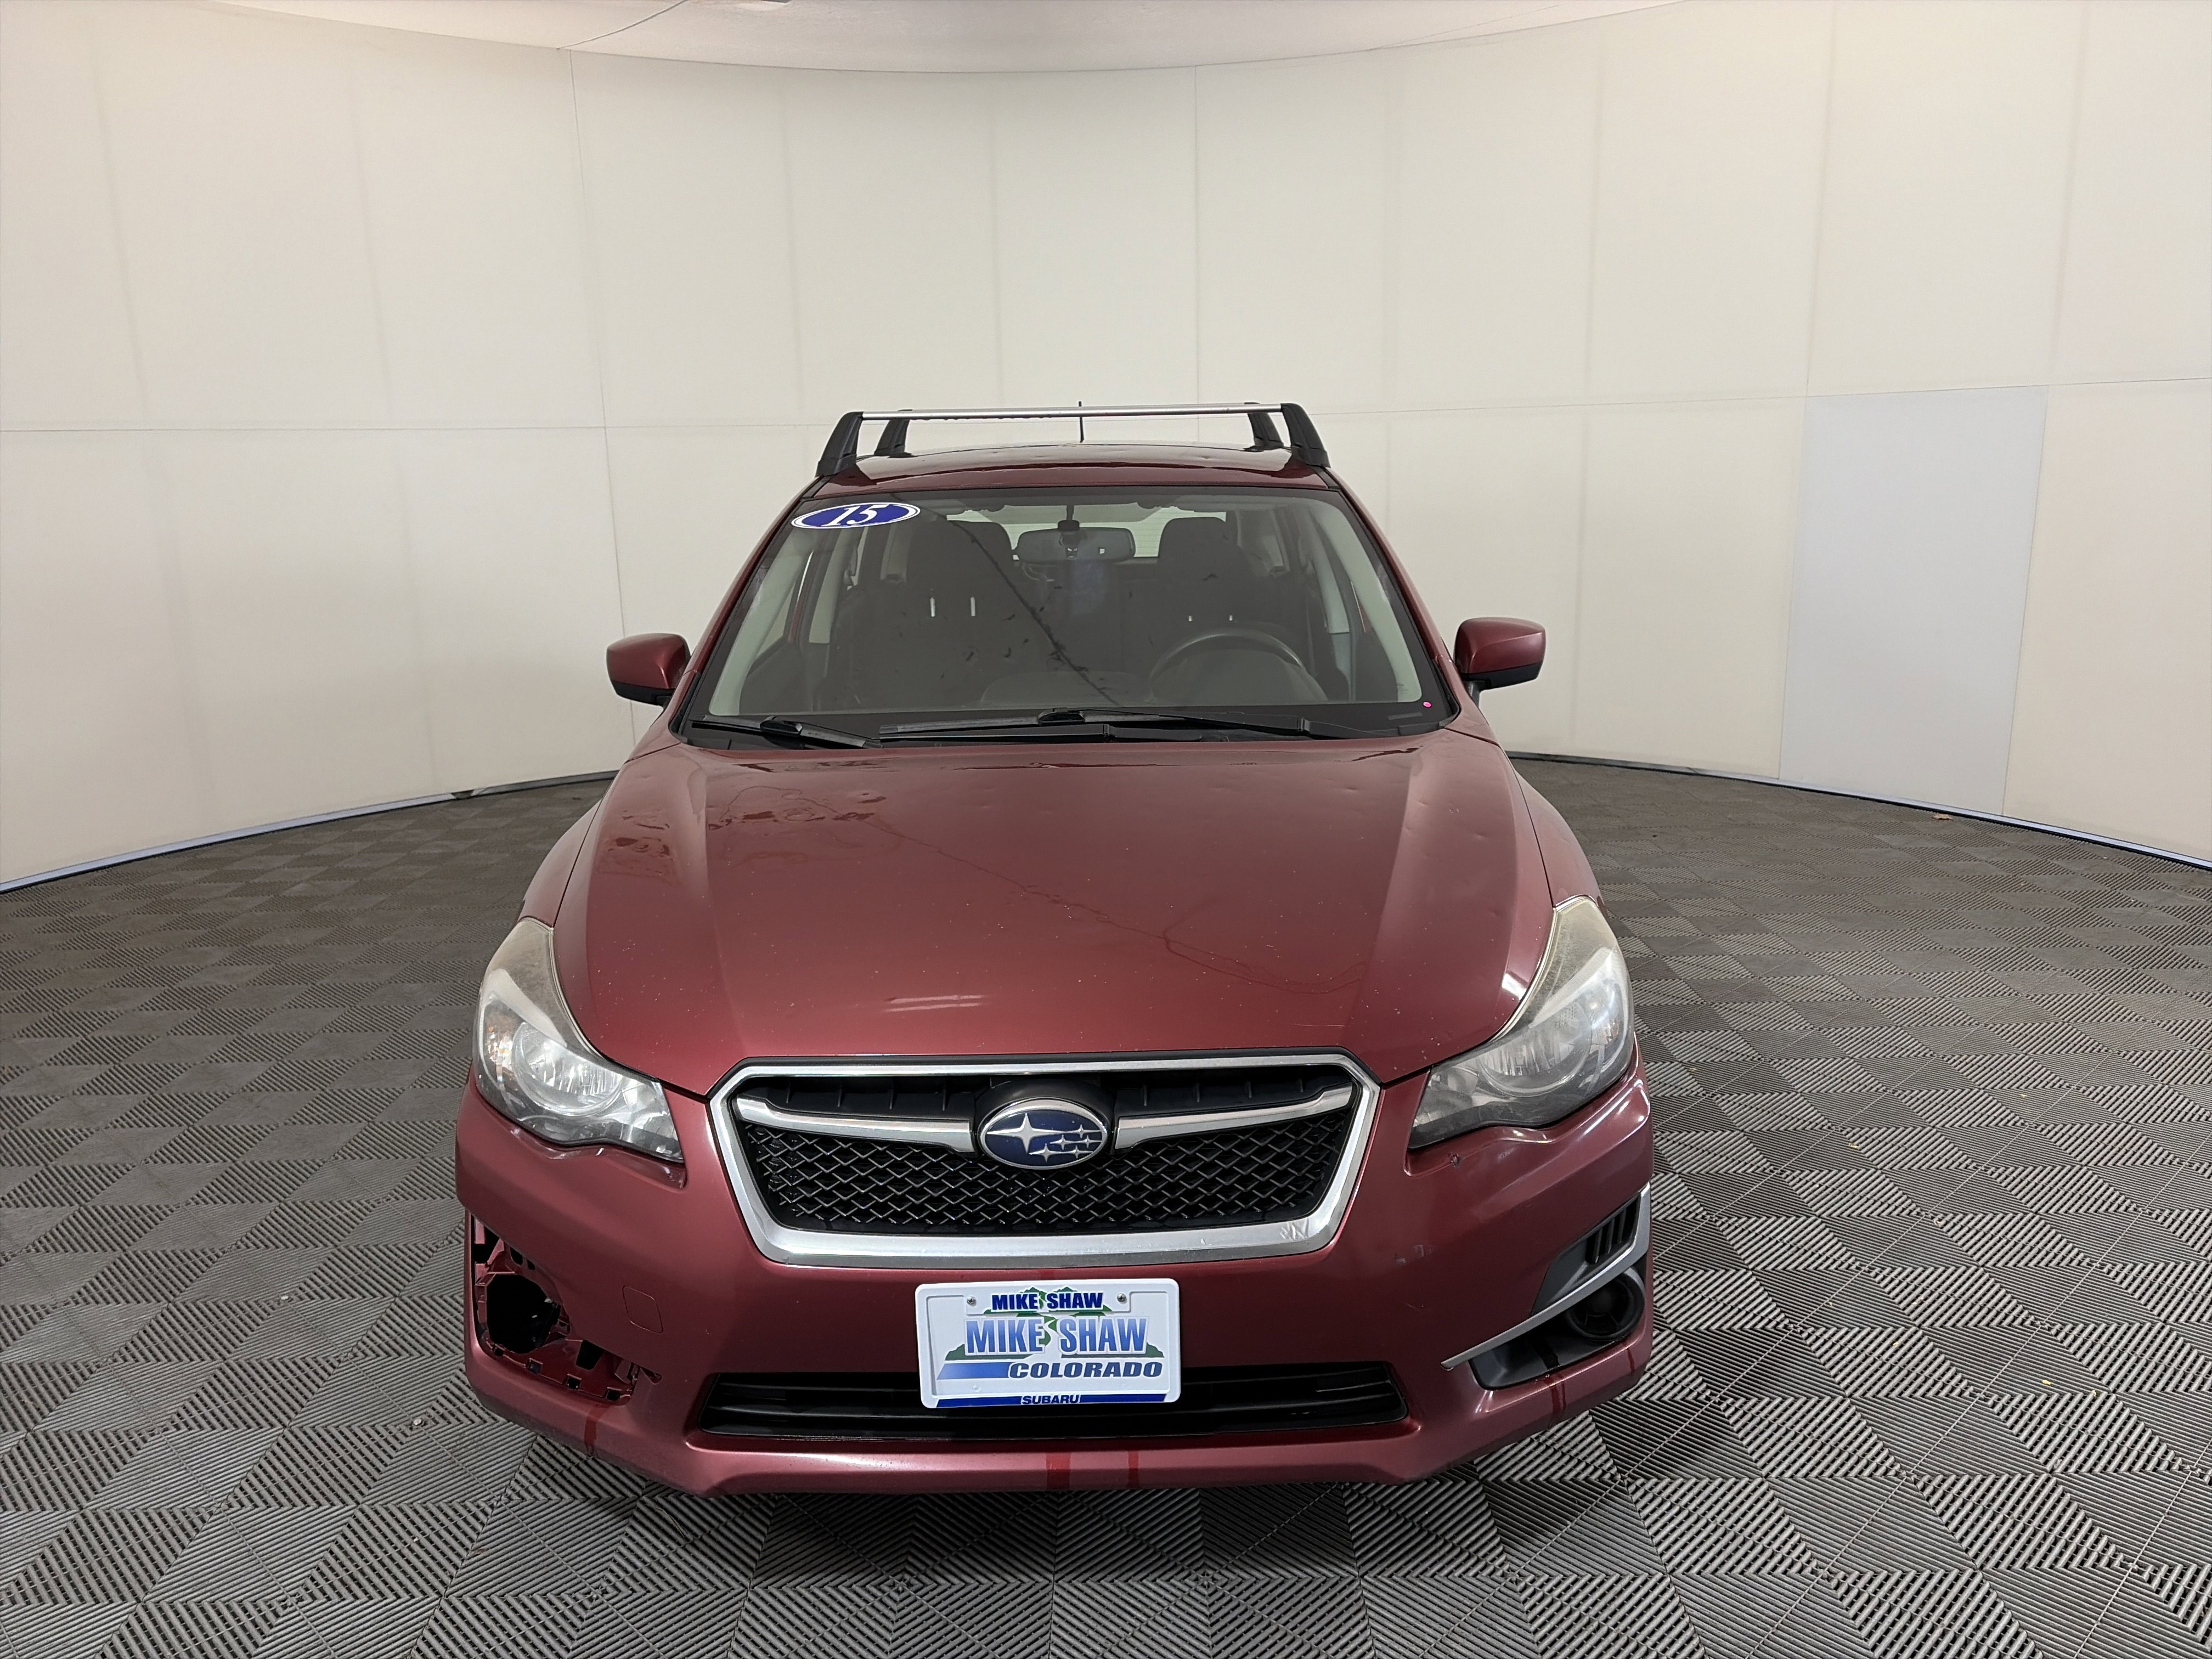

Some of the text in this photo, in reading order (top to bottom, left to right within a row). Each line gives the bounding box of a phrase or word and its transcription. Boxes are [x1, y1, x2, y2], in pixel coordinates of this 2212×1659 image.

[821, 503, 890, 527] 15
[991, 1292, 1103, 1310] MIKE SHAW
[966, 1318, 1147, 1353] MIKE SHAW
[1009, 1362, 1163, 1379] COLORADO
[1022, 1394, 1080, 1405] SUBARU
